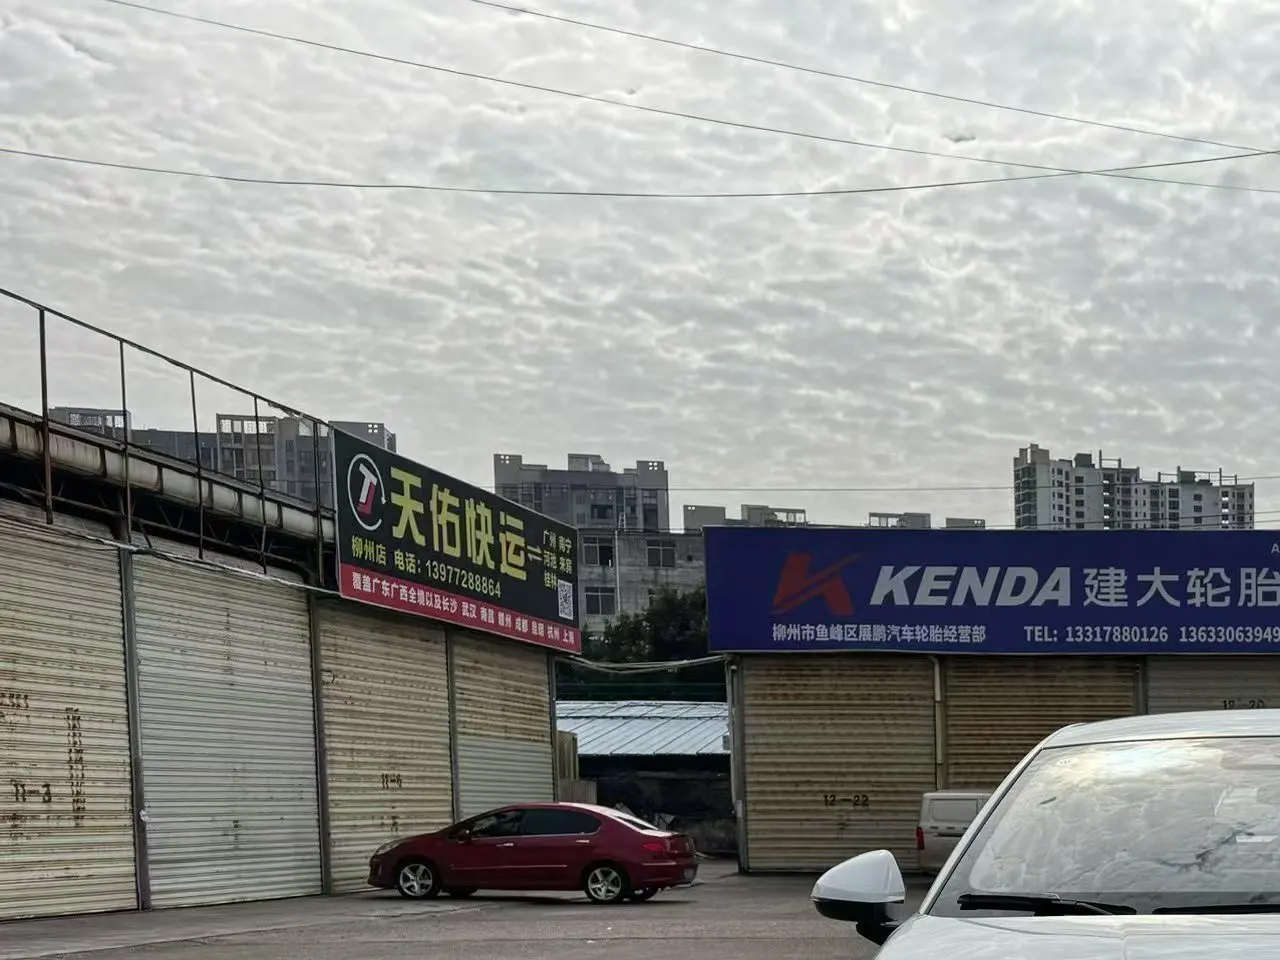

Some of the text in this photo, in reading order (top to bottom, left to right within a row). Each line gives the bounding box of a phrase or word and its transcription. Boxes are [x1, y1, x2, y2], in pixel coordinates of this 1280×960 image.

[390, 466, 527, 581] 天佑快运
[351, 535, 387, 566] 柳州店
[425, 559, 501, 598] 13977288864
[869, 565, 1072, 607] KENDA
[772, 623, 986, 643] 柳州市鱼峰区展鹏汽车轮胎经营部
[1024, 626, 1058, 643] TEL:
[1065, 626, 1169, 643] 13317880126
[823, 794, 869, 807] 12-22
